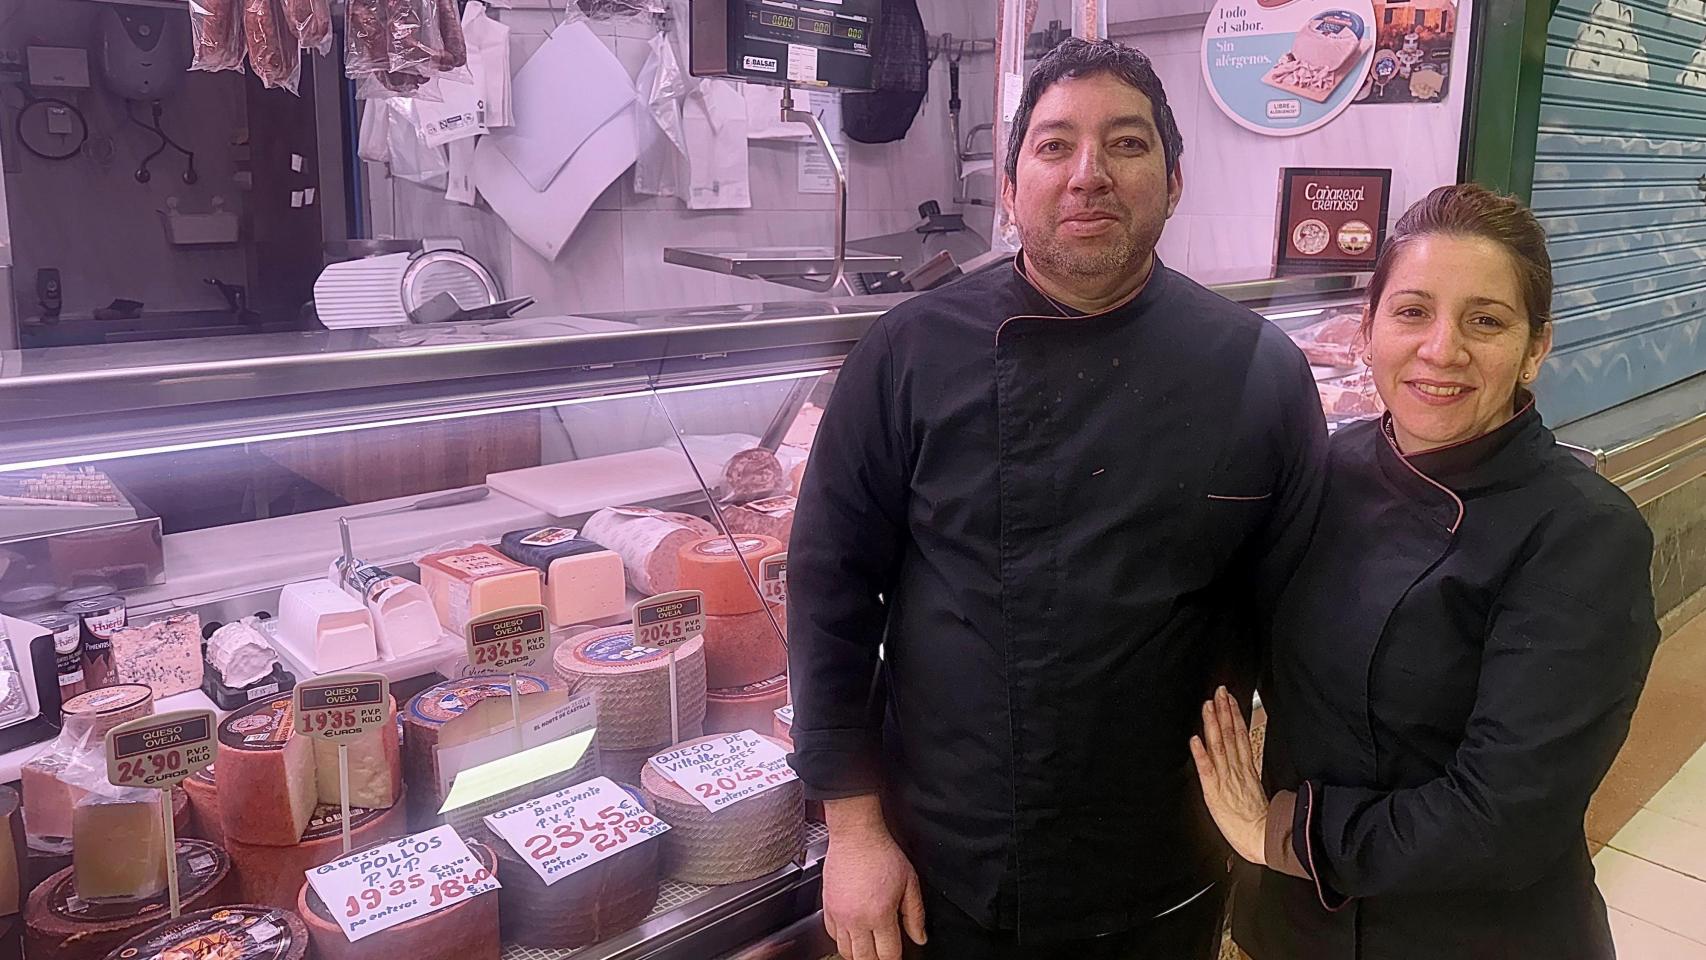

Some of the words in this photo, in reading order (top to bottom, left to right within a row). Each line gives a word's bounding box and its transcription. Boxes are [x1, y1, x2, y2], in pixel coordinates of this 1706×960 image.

[1219, 6, 1247, 19] Todo
[1217, 21, 1227, 33] el
[1230, 20, 1264, 33] sabor.
[1216, 41, 1235, 52] Sin
[1215, 53, 1272, 69] alérgenos.
[656, 603, 683, 613] QUESO
[658, 609, 682, 619] OVEJA
[492, 619, 523, 630] QUESO
[495, 626, 523, 636] OVEJA
[640, 621, 682, 644] 20'45
[685, 624, 701, 632] KILO
[475, 639, 523, 665] 23'45
[527, 642, 545, 651] KILO
[324, 687, 359, 697] QUESO
[326, 695, 357, 704] OVEJA
[302, 709, 356, 733] 19'35
[361, 708, 382, 716] P.V.P.
[541, 715, 559, 728] NORTE
[566, 701, 591, 715] CASTILLA
[142, 726, 183, 740] QUESO
[145, 734, 181, 748] OVEJA
[655, 743, 714, 765] QUESO
[722, 733, 744, 745] DE
[117, 750, 181, 783] 24'90
[186, 746, 211, 757] P.V.P.
[187, 753, 211, 764] KILO
[665, 753, 725, 773] Villalba
[729, 744, 742, 754] de
[699, 748, 756, 773] ALCORES
[534, 787, 601, 817] Benavente
[714, 786, 755, 806] enteros
[493, 800, 541, 820] Queso
[555, 789, 571, 799] de
[524, 806, 625, 860] 23'45
[617, 799, 633, 809] €
[590, 815, 655, 853] 21'90
[317, 850, 380, 874] Queso
[397, 837, 416, 848] de
[360, 836, 442, 874] POLLOS
[542, 855, 563, 869] por
[547, 852, 590, 874] enteros
[437, 867, 465, 880] Kilo
